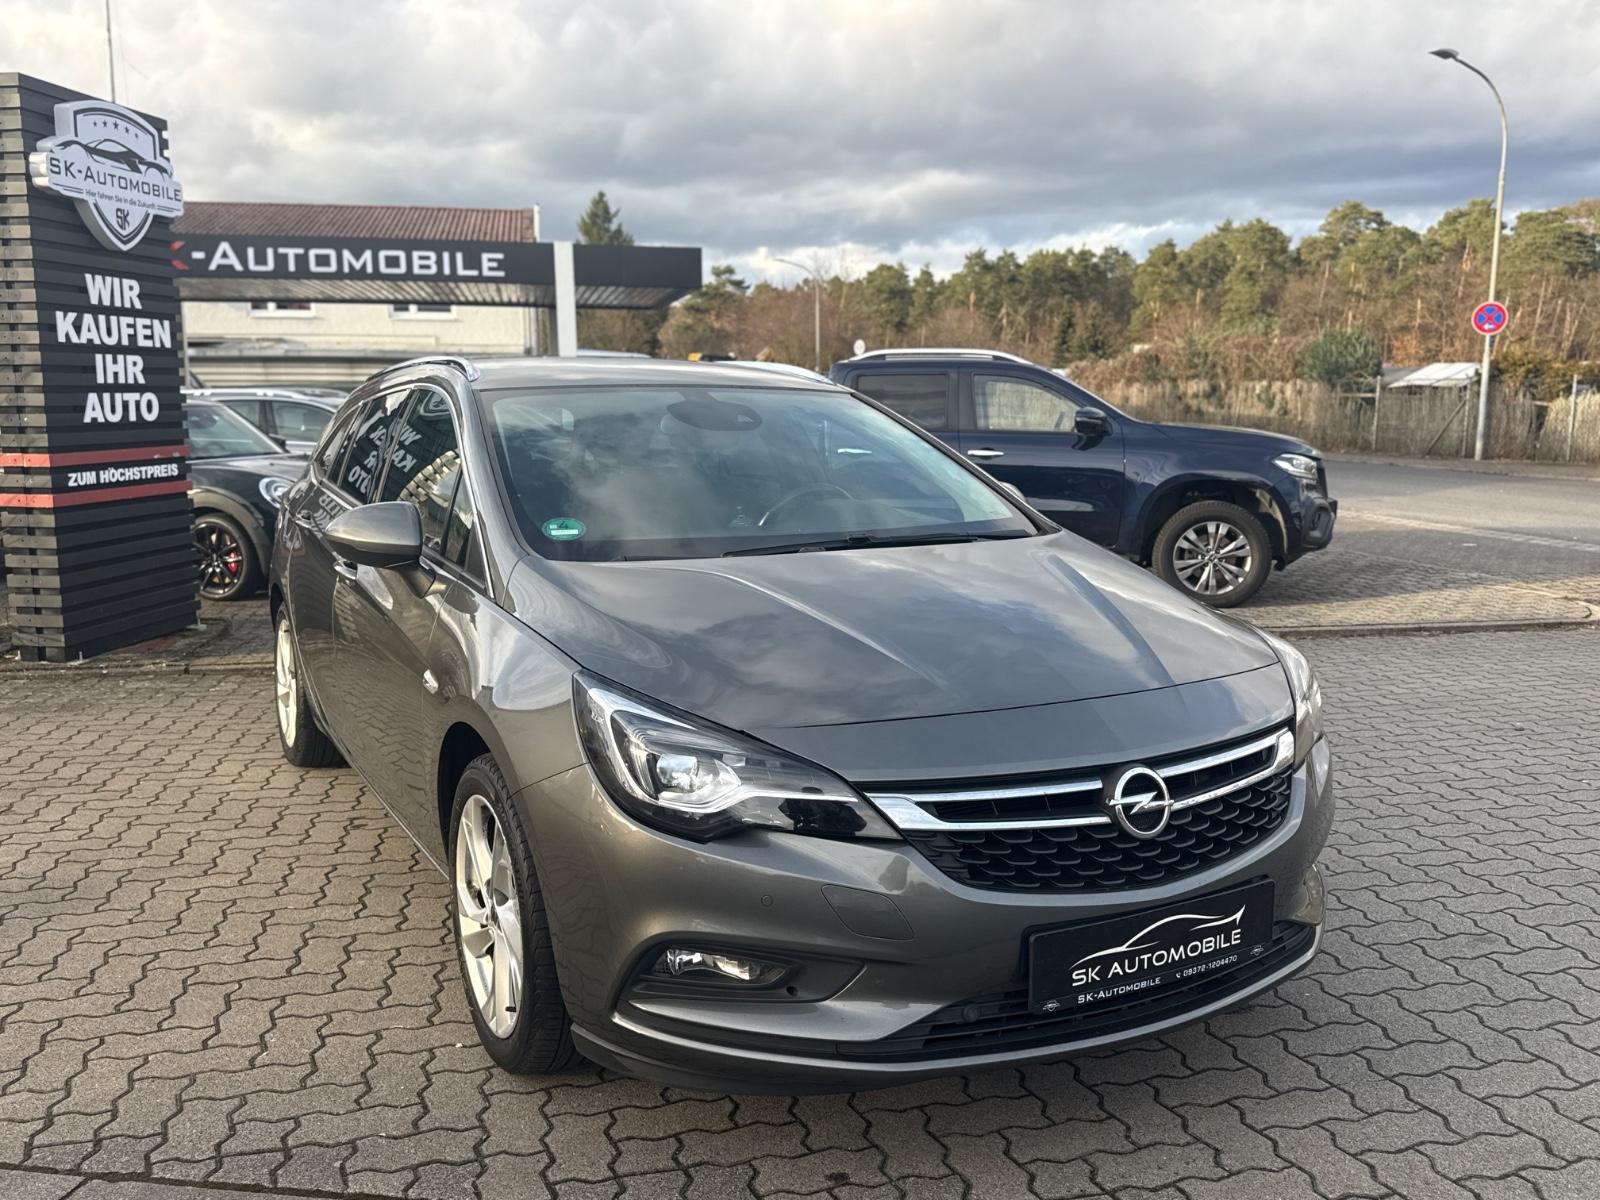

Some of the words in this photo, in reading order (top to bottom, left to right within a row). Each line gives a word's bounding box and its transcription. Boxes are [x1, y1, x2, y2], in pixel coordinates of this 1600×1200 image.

[50, 157, 182, 202] SK-AUTOMOBILE
[116, 208, 130, 231] SK
[84, 273, 142, 309] WIR
[55, 310, 172, 349] KAUFEN
[95, 353, 146, 384] IHR
[83, 391, 159, 423] AUTO
[68, 470, 97, 487] ZUM
[100, 463, 179, 483] HÖCHSTPREIS
[1071, 965, 1101, 987] SK
[1107, 929, 1242, 979] AUTOMOBILE
[1077, 977, 1161, 1004] SK-AUTOMOBILE
